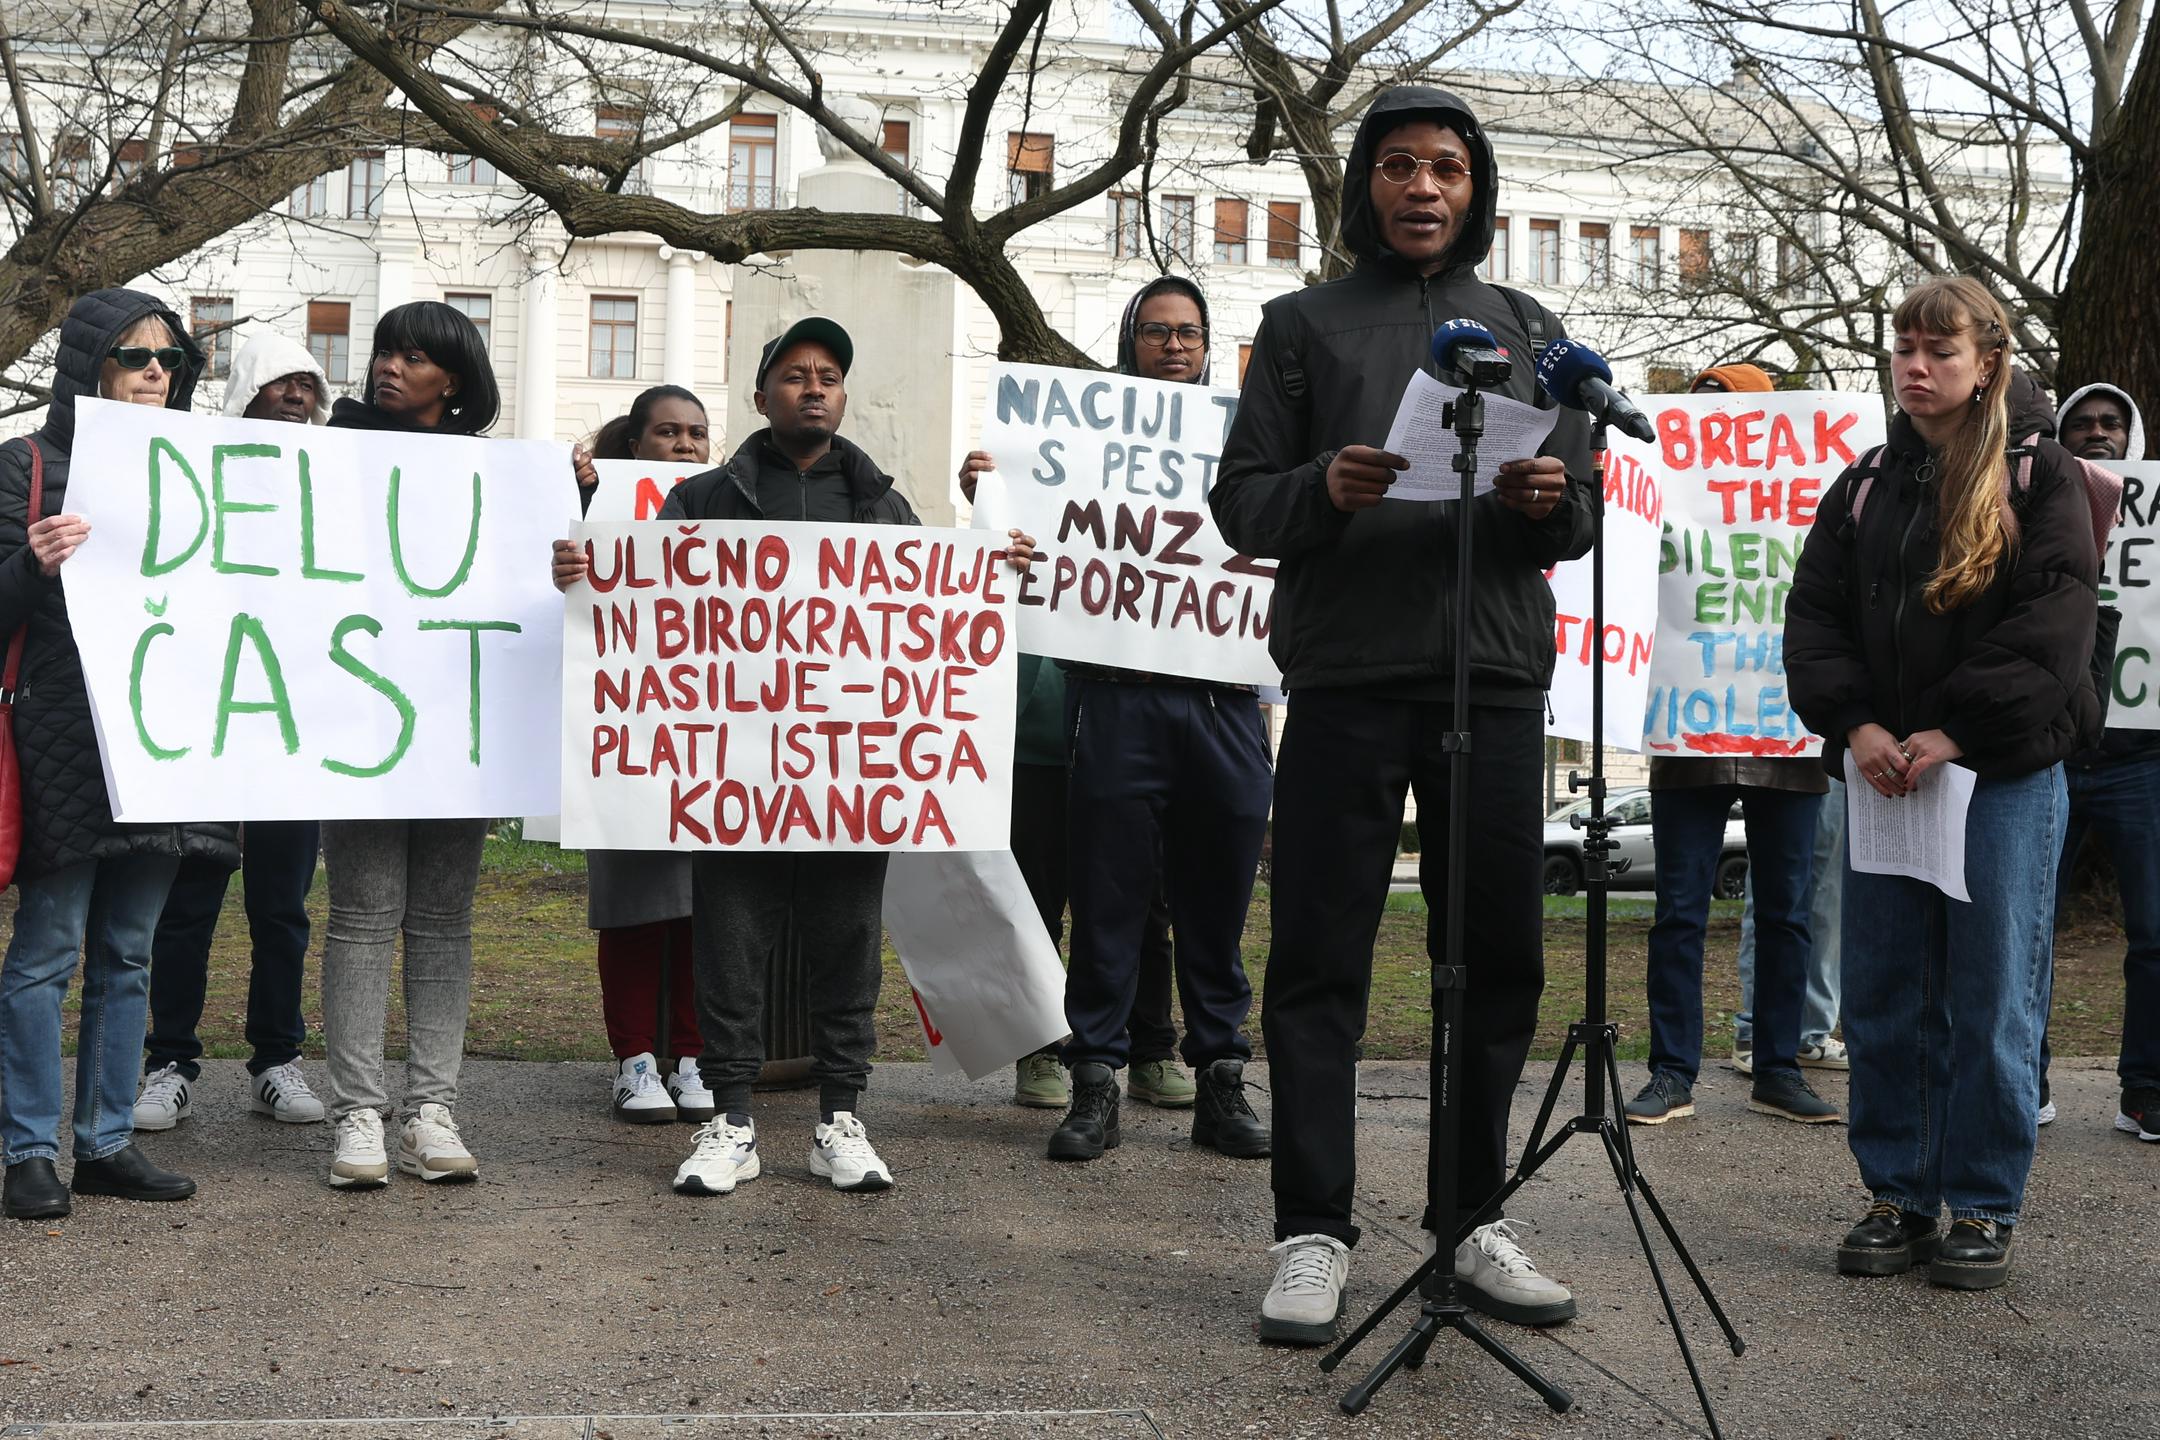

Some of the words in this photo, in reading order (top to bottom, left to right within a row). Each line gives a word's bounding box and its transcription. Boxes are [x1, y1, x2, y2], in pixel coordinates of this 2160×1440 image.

[1547, 346, 1569, 371] SLO
[996, 374, 1183, 442] NACIJI
[1656, 408, 1859, 471] BREAK
[1032, 439, 1067, 487] S
[1102, 441, 1220, 505] PEST
[1707, 478, 1822, 526] THE
[140, 436, 482, 599] DELU
[1057, 498, 1205, 566] MNZ
[585, 524, 791, 602] ULIČNO
[818, 537, 1006, 604] NASILJE
[1659, 520, 1803, 582] SILEN
[1017, 552, 1276, 641] EPORTACIJ
[592, 600, 638, 659] IN
[654, 596, 1005, 667] BIROKRATSKO
[1555, 613, 1654, 677] TION
[129, 593, 522, 778] ČAST
[593, 658, 831, 716] NASILJE
[881, 665, 980, 721] DVE
[1643, 684, 1797, 740] IOLE
[591, 722, 728, 779] PLATI
[771, 721, 988, 785] ISTEGA
[668, 778, 957, 847] KOVANCA
